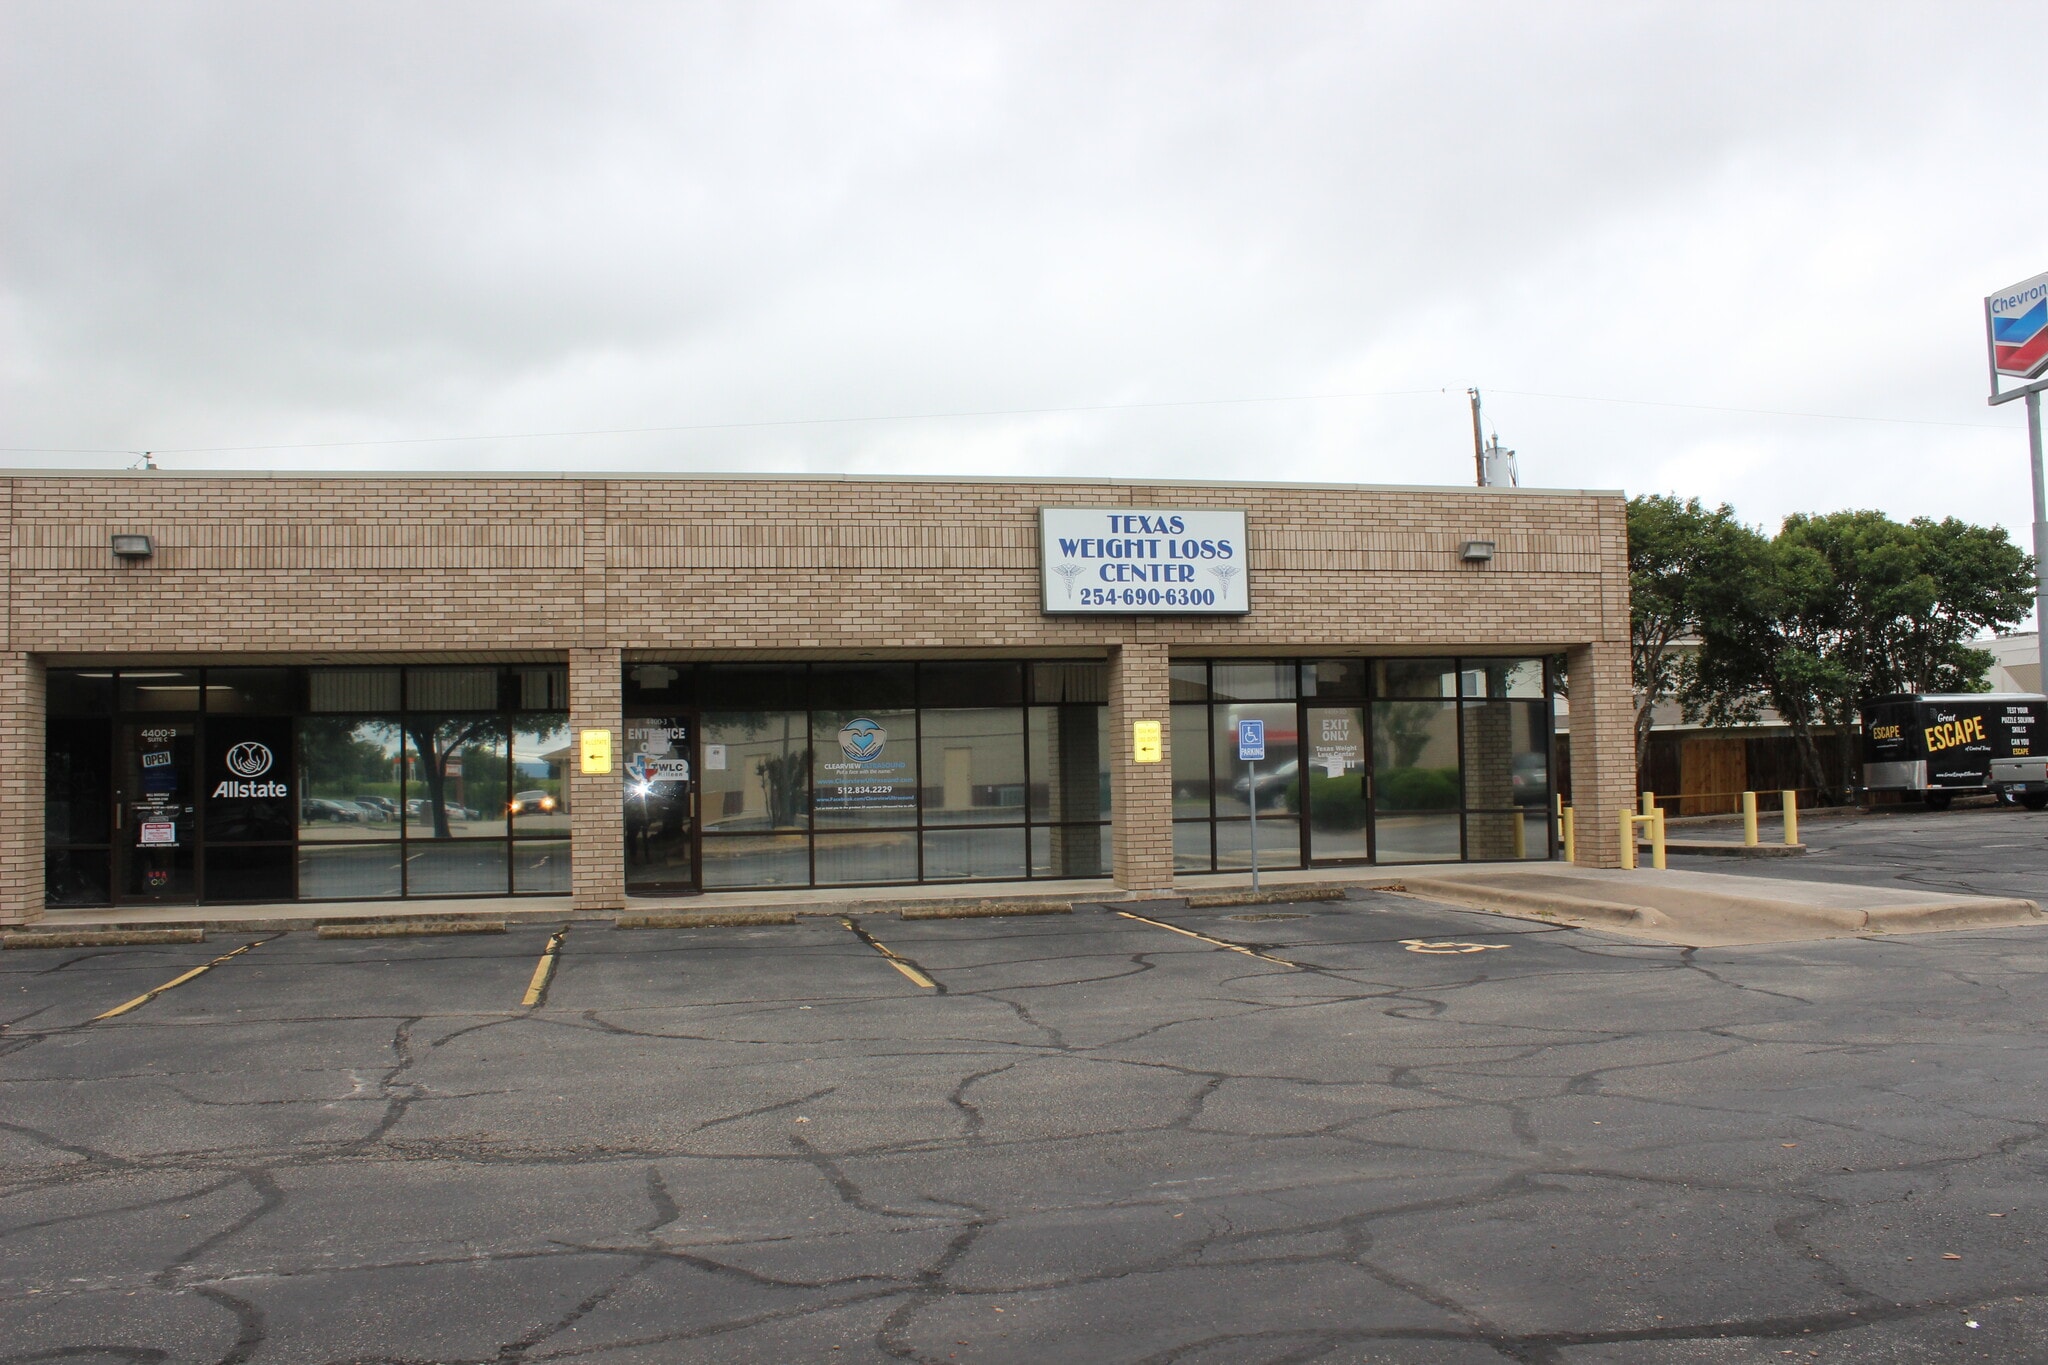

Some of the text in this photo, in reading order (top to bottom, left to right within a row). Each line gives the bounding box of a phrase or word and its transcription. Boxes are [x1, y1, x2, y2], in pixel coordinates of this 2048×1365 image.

[1992, 284, 2047, 313] Chevron
[1107, 515, 1185, 534] TEXAS
[1058, 538, 1233, 559] WEIGHT LOSS
[1099, 563, 1195, 582] CENTER
[1080, 588, 1215, 605] 254-690-6300
[1322, 719, 1349, 730] EXIT
[1937, 713, 1956, 723] Great
[2001, 716, 2035, 724] PUZZLE SOLVING
[141, 728, 177, 737] 4400-3
[628, 727, 686, 740] ENTNCE
[1322, 730, 1349, 742] ONLY
[1873, 725, 1900, 740] ESCAPE
[1924, 715, 1986, 752] ESCAPE
[2011, 738, 2029, 746] CAN YOU
[1241, 747, 1263, 756] PARKING
[145, 752, 169, 766] OPEN
[211, 780, 288, 798] Allstate
[837, 785, 892, 794] 512.834.2229
